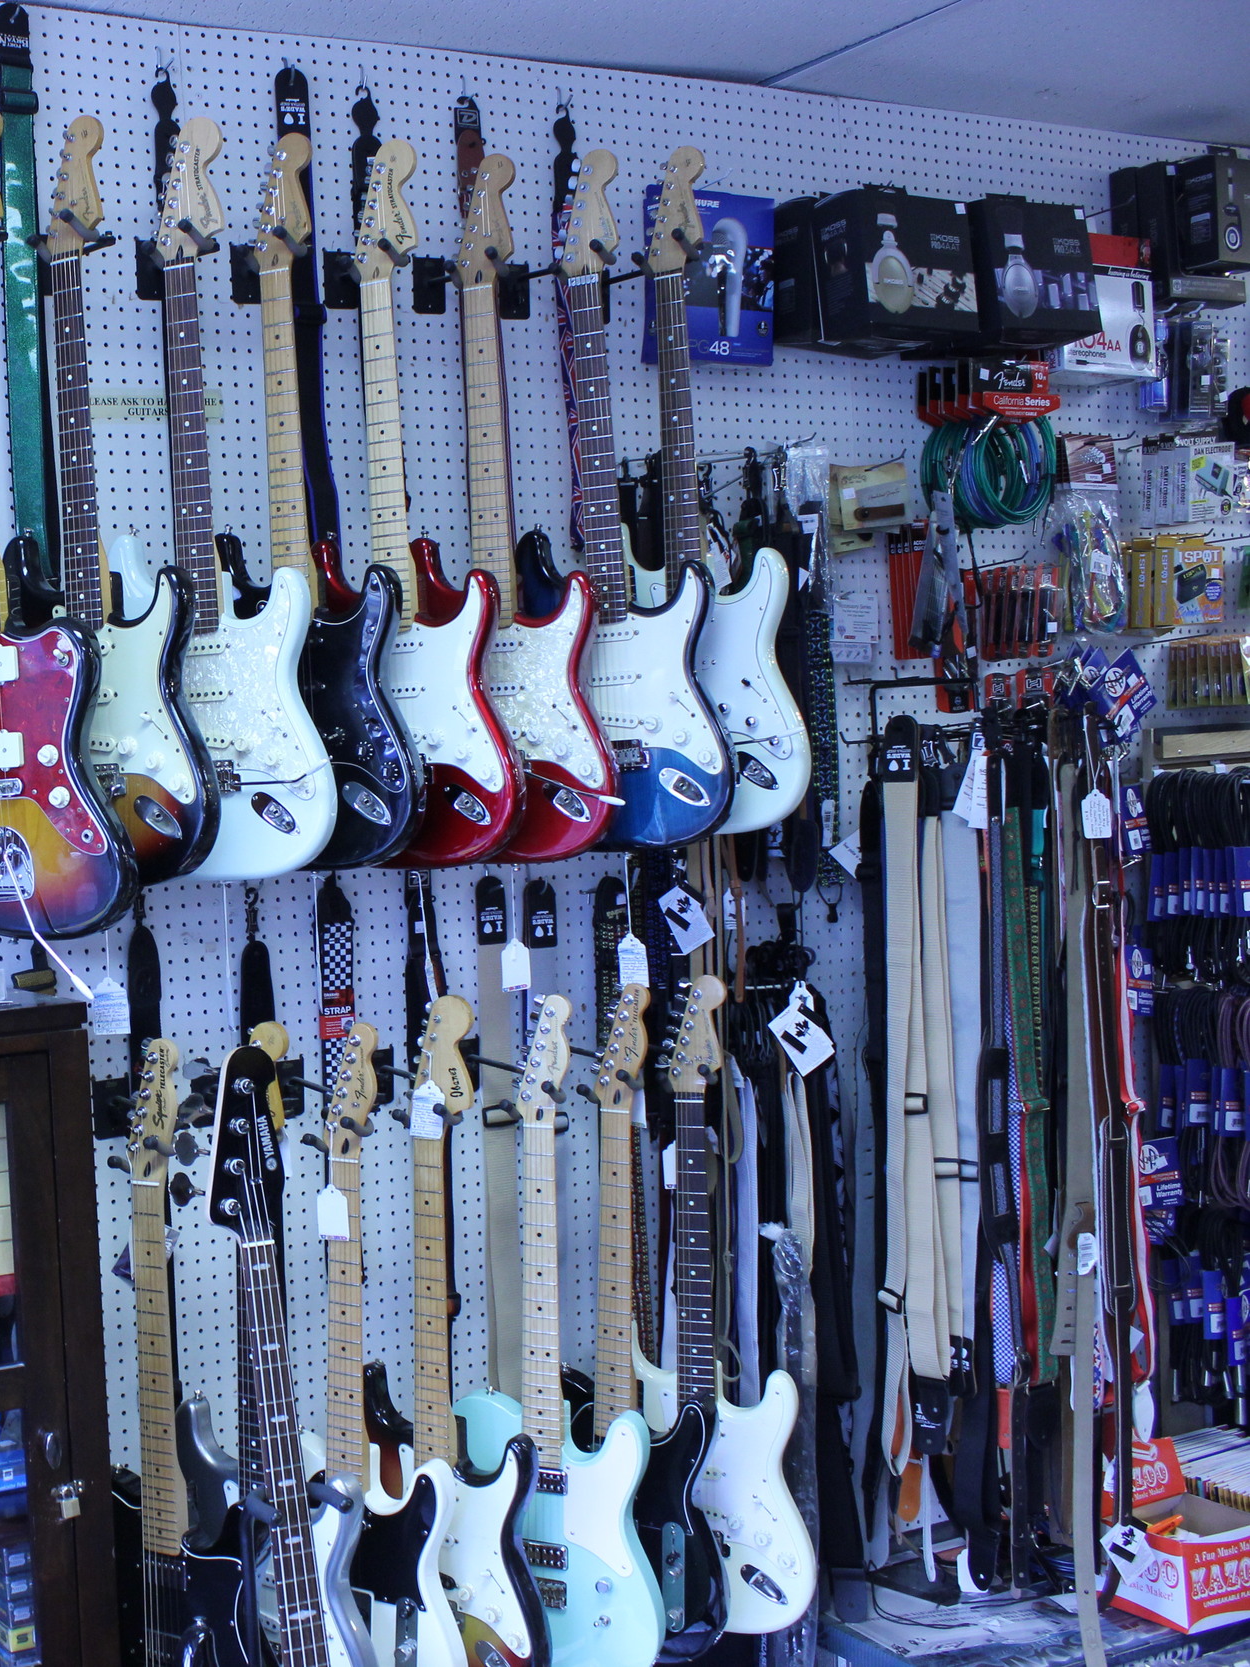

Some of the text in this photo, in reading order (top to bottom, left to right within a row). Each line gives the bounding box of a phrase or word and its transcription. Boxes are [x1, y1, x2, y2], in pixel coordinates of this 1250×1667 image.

[193, 145, 203, 191] STRATOCASTER
[387, 168, 412, 245] Fender STRATOCASTER
[695, 198, 720, 209] HURE
[936, 234, 961, 244] KOSS
[1059, 238, 1080, 247] KOSS
[993, 371, 1026, 390] Fender
[89, 397, 118, 406] LEASE
[120, 398, 139, 406] ASK
[140, 398, 154, 406] TO
[993, 395, 1050, 407] California Series
[127, 408, 168, 416] GUITARS
[1180, 438, 1194, 446] VOLT
[1194, 436, 1216, 445] SUPPLY
[1184, 549, 1220, 563] SPOT
[1131, 685, 1149, 704] Lifetime
[1133, 689, 1153, 711] Warranty
[324, 1006, 351, 1015] STRAP
[624, 988, 640, 1058] Fender TELECASTER
[547, 1040, 560, 1075] Fender
[354, 1072, 368, 1100] Fender
[448, 1067, 464, 1098] Ibanez
[153, 1089, 167, 1130] Squier
[257, 1115, 275, 1158] YAMAHA
[1155, 1189, 1183, 1199] Warranty
[1156, 1182, 1181, 1192] Lifetime
[1148, 1486, 1165, 1498] Maker!
[1194, 1553, 1200, 1564] A
[1202, 1550, 1216, 1562] Fun
[1217, 1545, 1239, 1560] Music
[1145, 1583, 1174, 1602] Maker!
[1203, 1593, 1241, 1608] UNBREAKABLE
